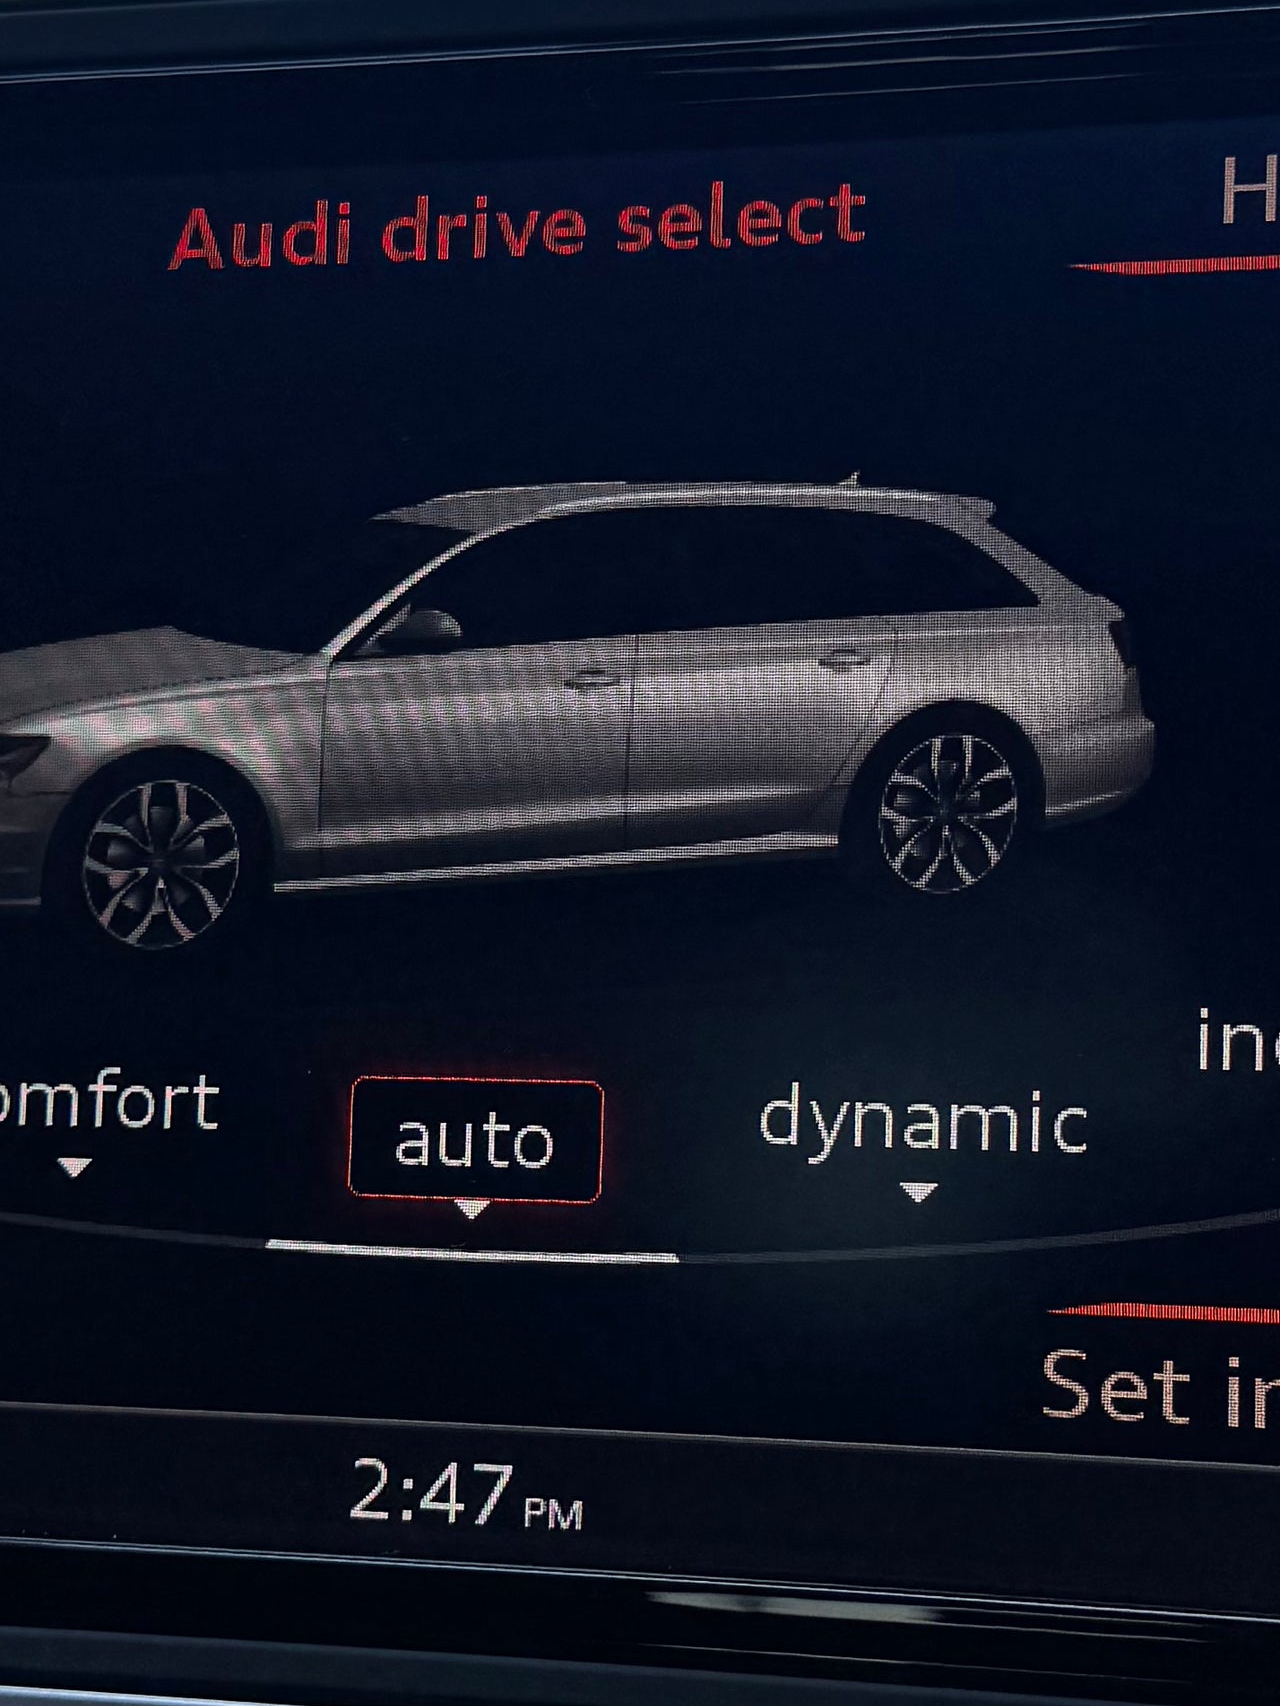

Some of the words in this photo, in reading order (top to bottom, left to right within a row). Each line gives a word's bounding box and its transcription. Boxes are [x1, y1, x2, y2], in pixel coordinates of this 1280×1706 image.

[168, 199, 352, 271] Audi
[380, 194, 588, 263] drive
[616, 179, 867, 254] select
[394, 1110, 555, 1170] auto
[759, 1080, 1089, 1166] dynamic
[1041, 1347, 1192, 1426] Set
